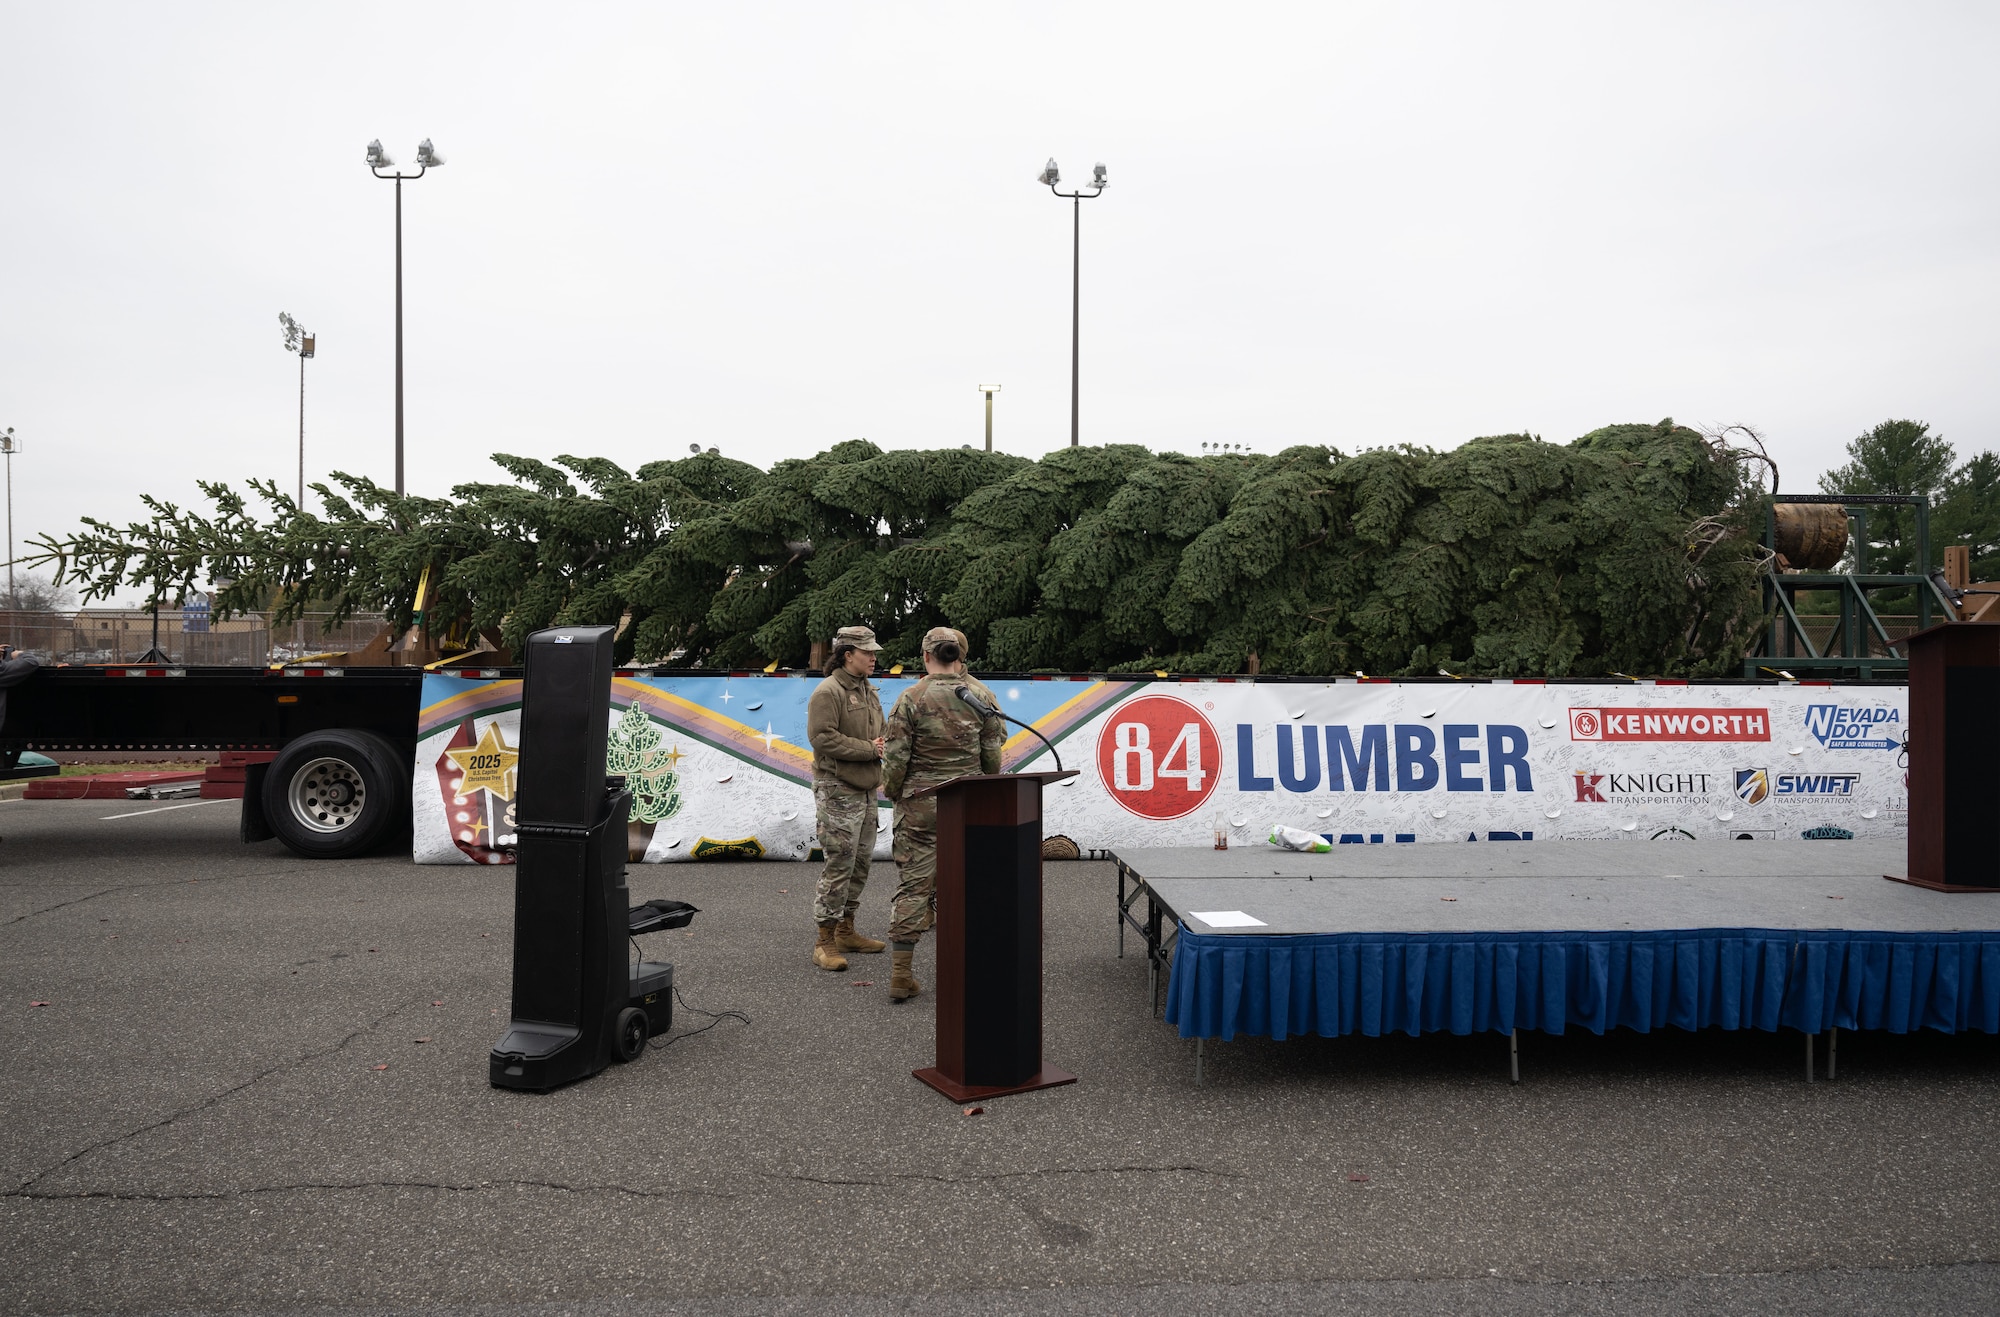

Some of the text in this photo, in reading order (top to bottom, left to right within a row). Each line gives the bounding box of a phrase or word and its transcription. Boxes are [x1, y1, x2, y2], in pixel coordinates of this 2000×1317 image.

[1606, 714, 1765, 735] KENWORTH
[1831, 724, 1874, 738] DOT
[469, 754, 501, 770] 2025
[1113, 722, 1206, 792] 84
[1236, 724, 1535, 793] LUMBER
[1609, 773, 1711, 793] KNIGHT
[1777, 776, 1857, 793] SWIFT
[1610, 796, 1710, 805] TRANSPORTATION
[1773, 797, 1852, 805] TRANSPORTATION
[699, 845, 726, 857] FOREST
[796, 840, 807, 851] OF
